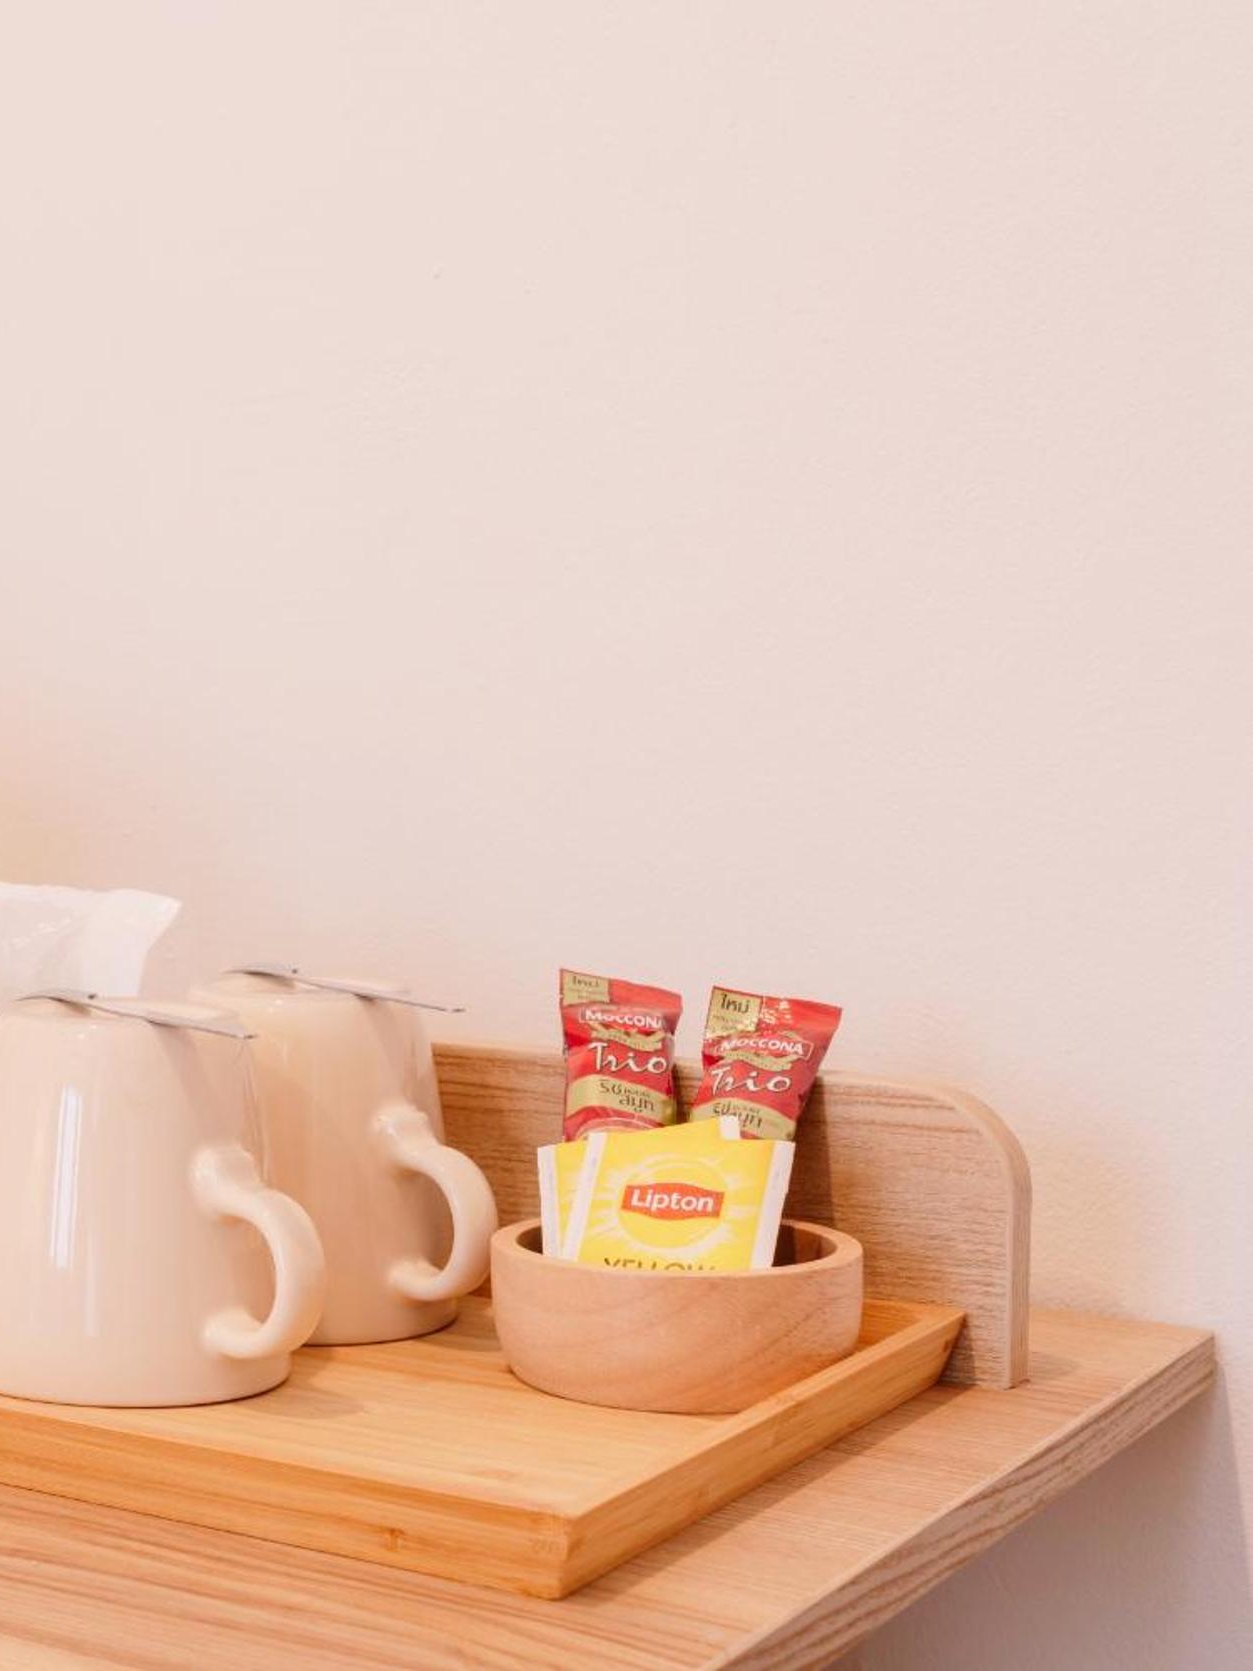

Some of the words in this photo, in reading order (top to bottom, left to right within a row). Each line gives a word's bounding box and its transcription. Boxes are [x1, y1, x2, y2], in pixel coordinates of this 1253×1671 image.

[587, 1041, 668, 1074] Trio
[720, 1037, 804, 1056] MOCCONA
[709, 1066, 792, 1095] Trio
[630, 1188, 715, 1212] Lipton
